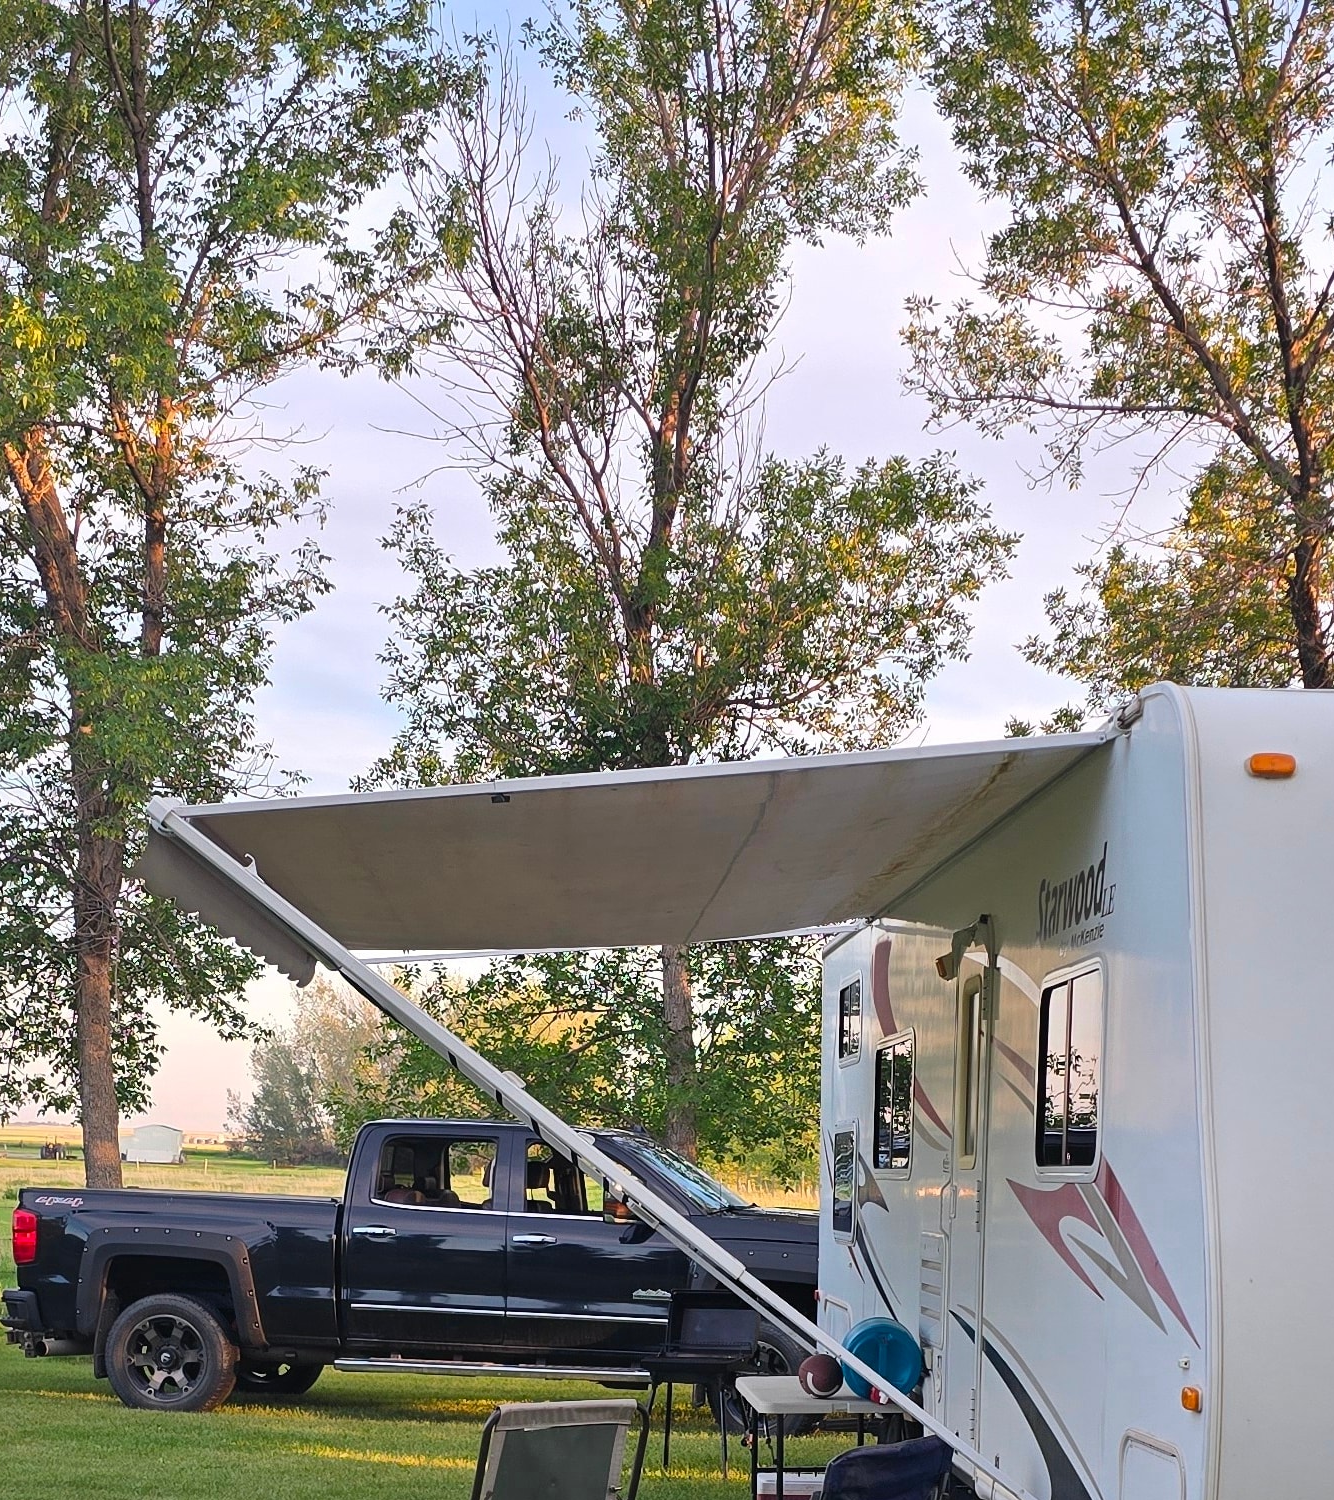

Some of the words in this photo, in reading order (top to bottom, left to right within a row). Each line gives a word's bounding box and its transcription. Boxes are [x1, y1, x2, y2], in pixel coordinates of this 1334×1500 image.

[1036, 841, 1107, 948] Starwood
[1101, 883, 1117, 918] LE
[1071, 922, 1105, 949] McKenzie
